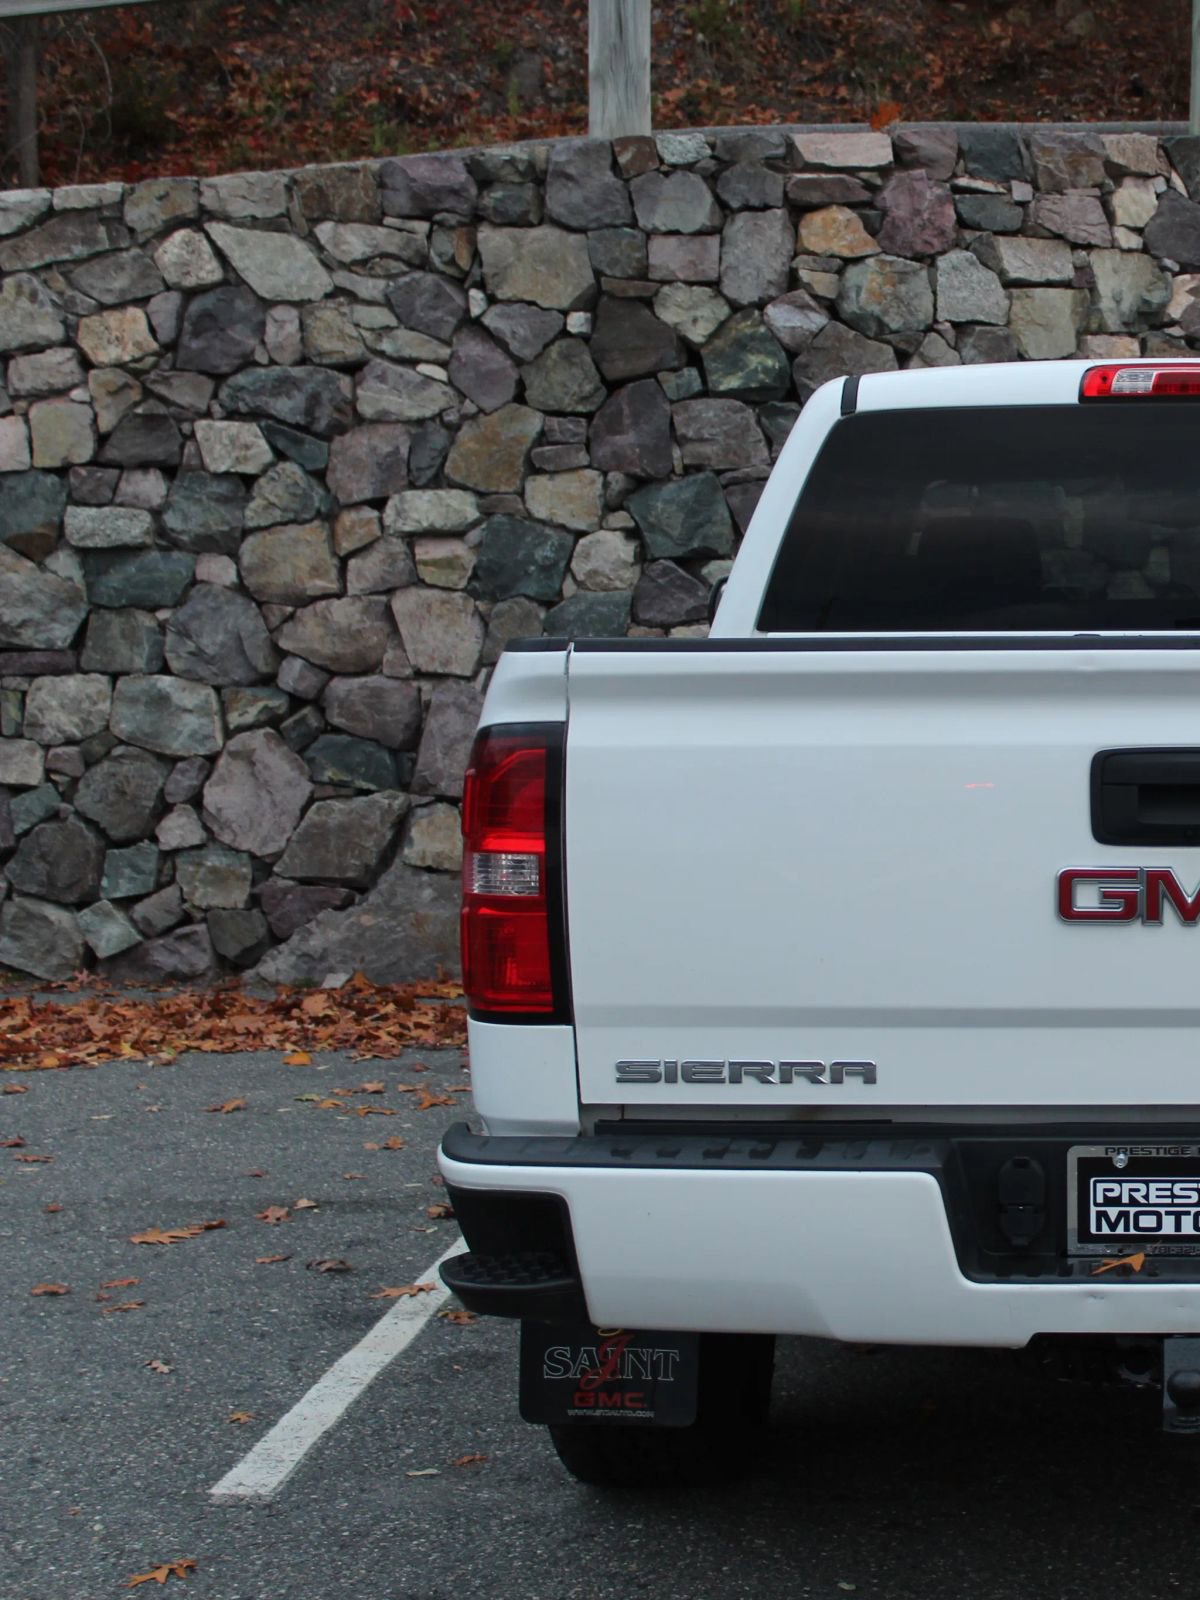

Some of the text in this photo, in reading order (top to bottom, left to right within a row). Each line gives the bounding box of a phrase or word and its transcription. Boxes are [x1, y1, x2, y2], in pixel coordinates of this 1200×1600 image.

[615, 1059, 877, 1084] SIERRA
[1104, 1146, 1191, 1156] PRESTIGE
[573, 1391, 646, 1409] GMC
